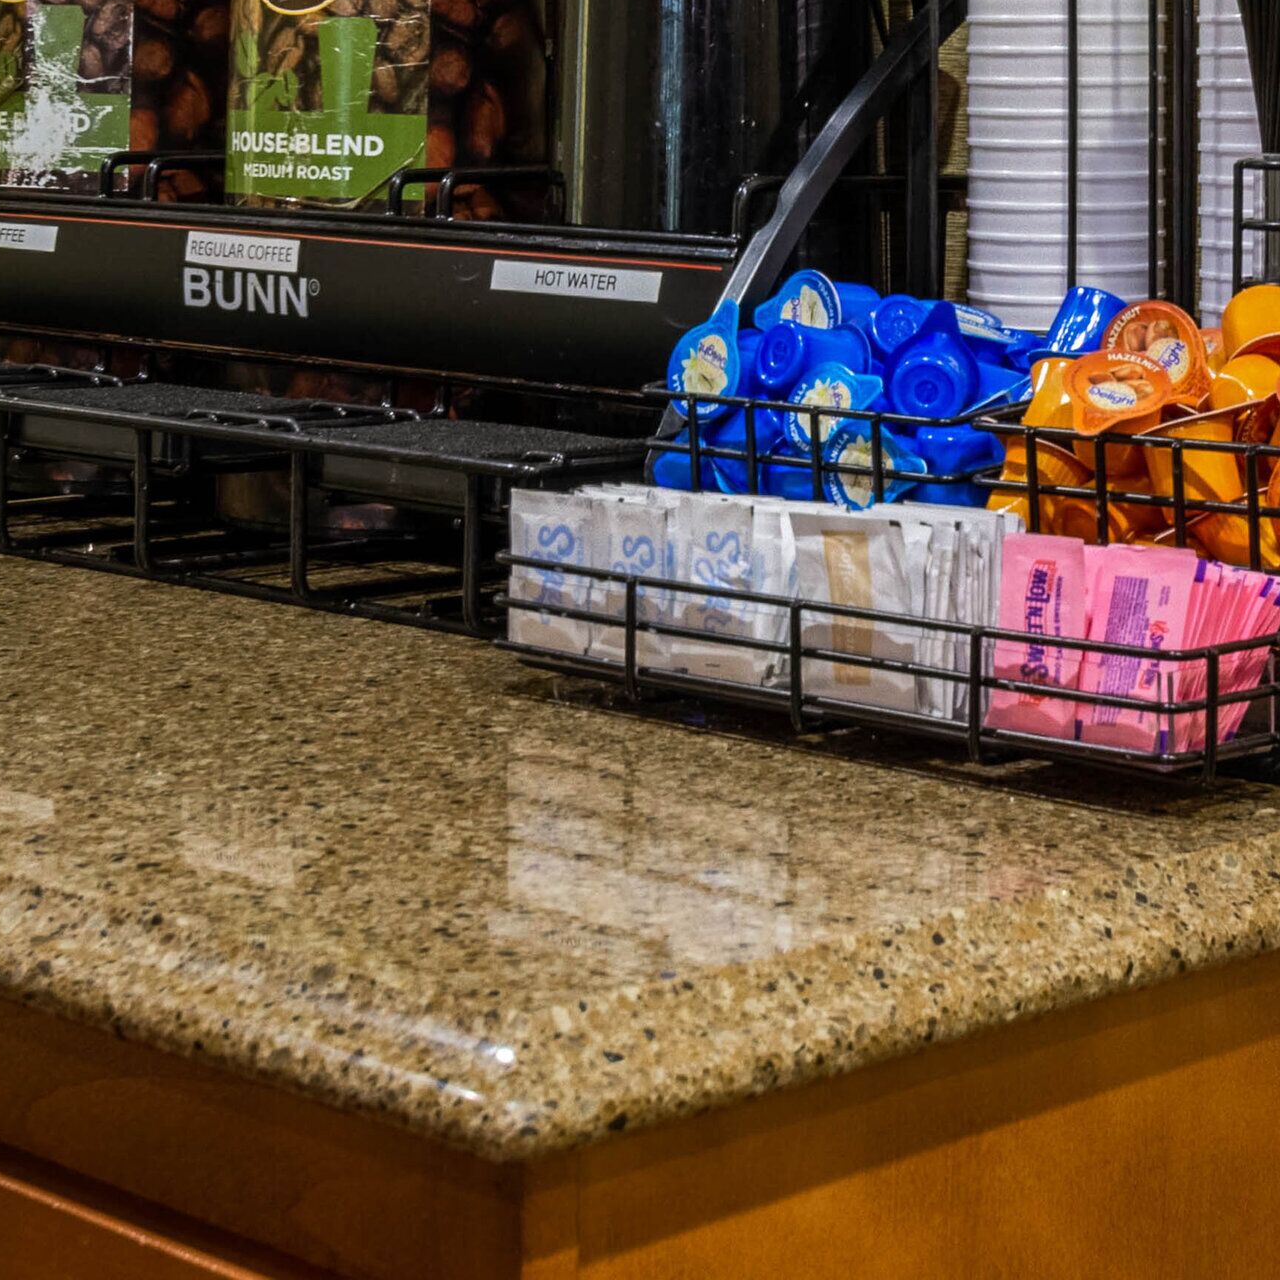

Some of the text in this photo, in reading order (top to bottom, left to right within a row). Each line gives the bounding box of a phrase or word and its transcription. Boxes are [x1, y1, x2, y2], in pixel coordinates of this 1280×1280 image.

[231, 131, 385, 157] HOUSE BLEND
[243, 162, 354, 181] MEDIUM ROAST
[190, 240, 293, 263] REGULAR COFFEE
[534, 270, 618, 291] HOT WATER
[1108, 353, 1161, 373] HAZELNUT
[1089, 385, 1136, 407] Delight
